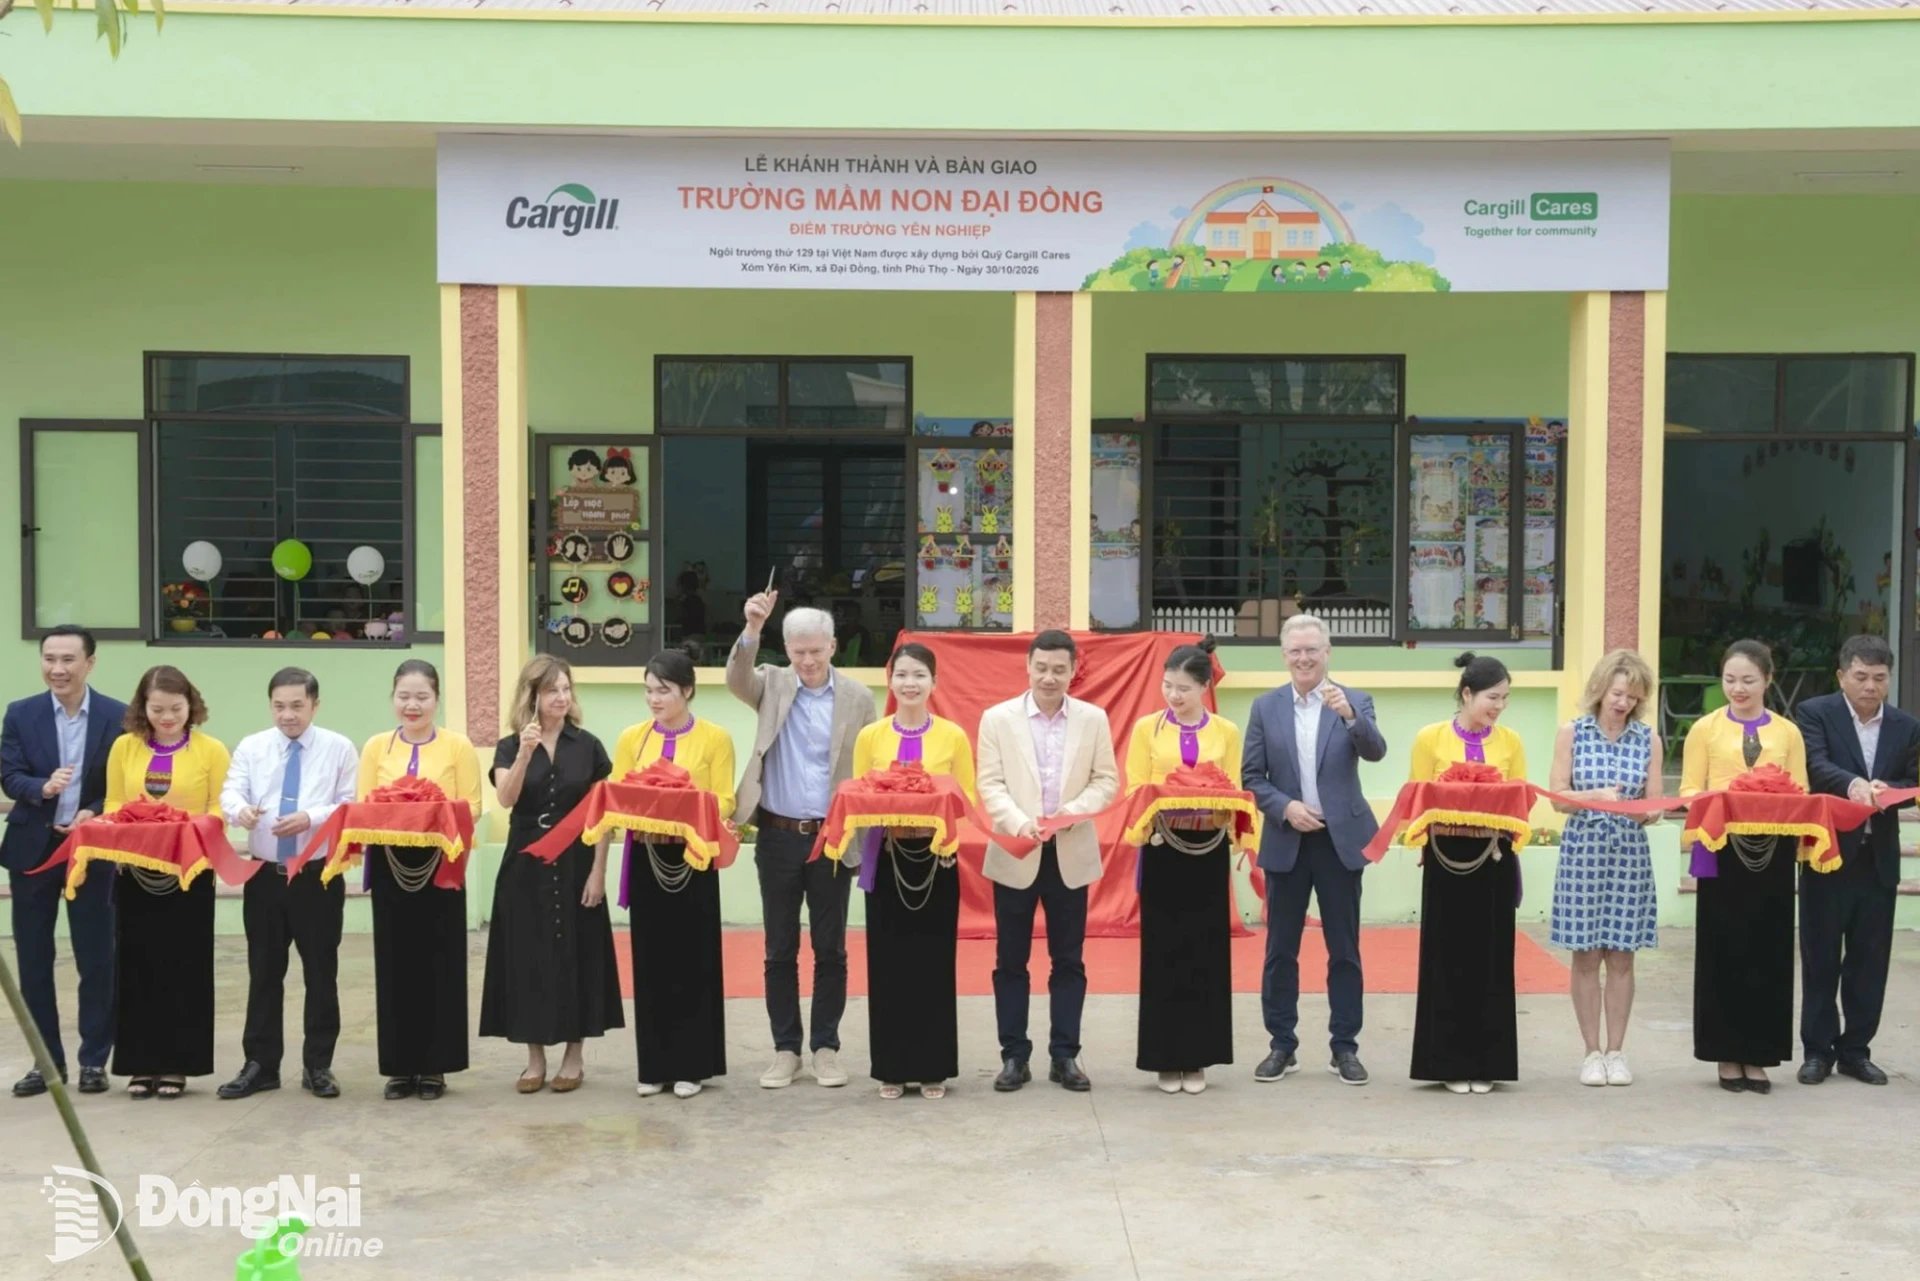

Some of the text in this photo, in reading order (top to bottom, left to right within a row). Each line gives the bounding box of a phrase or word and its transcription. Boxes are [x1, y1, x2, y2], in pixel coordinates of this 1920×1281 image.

[745, 153, 1038, 175] LỄ KHÁNH THÀNH VÀ BÀN GIAO
[677, 182, 806, 211] TRƯỜNG
[891, 189, 952, 213] NON
[961, 190, 1010, 218] ĐẠI
[1464, 198, 1593, 219] Cargill Cares
[505, 196, 620, 237] Cargill
[831, 221, 897, 236] TRƯỜNG
[901, 222, 931, 236] YÊN
[935, 225, 991, 240] NGHIỆP
[1464, 226, 1598, 238] Together for community
[709, 247, 734, 257] Ngôi
[796, 248, 814, 257] 129
[816, 248, 829, 259] tại
[832, 248, 851, 260] Việt
[854, 249, 877, 258] Nam
[880, 249, 908, 260] được
[911, 249, 929, 260] xây
[931, 249, 959, 260] dựng
[1005, 250, 1038, 261] Cargill
[1041, 250, 1070, 260] Cares
[741, 262, 764, 272] Xóm
[767, 262, 787, 272] Yên
[789, 262, 813, 273] Kim,
[815, 263, 827, 273] xã
[830, 264, 847, 275] Đại
[905, 264, 926, 274] Phú
[928, 265, 948, 276] Thọ
[957, 264, 983, 276] Ngày
[986, 265, 1040, 275] 30/10/2026
